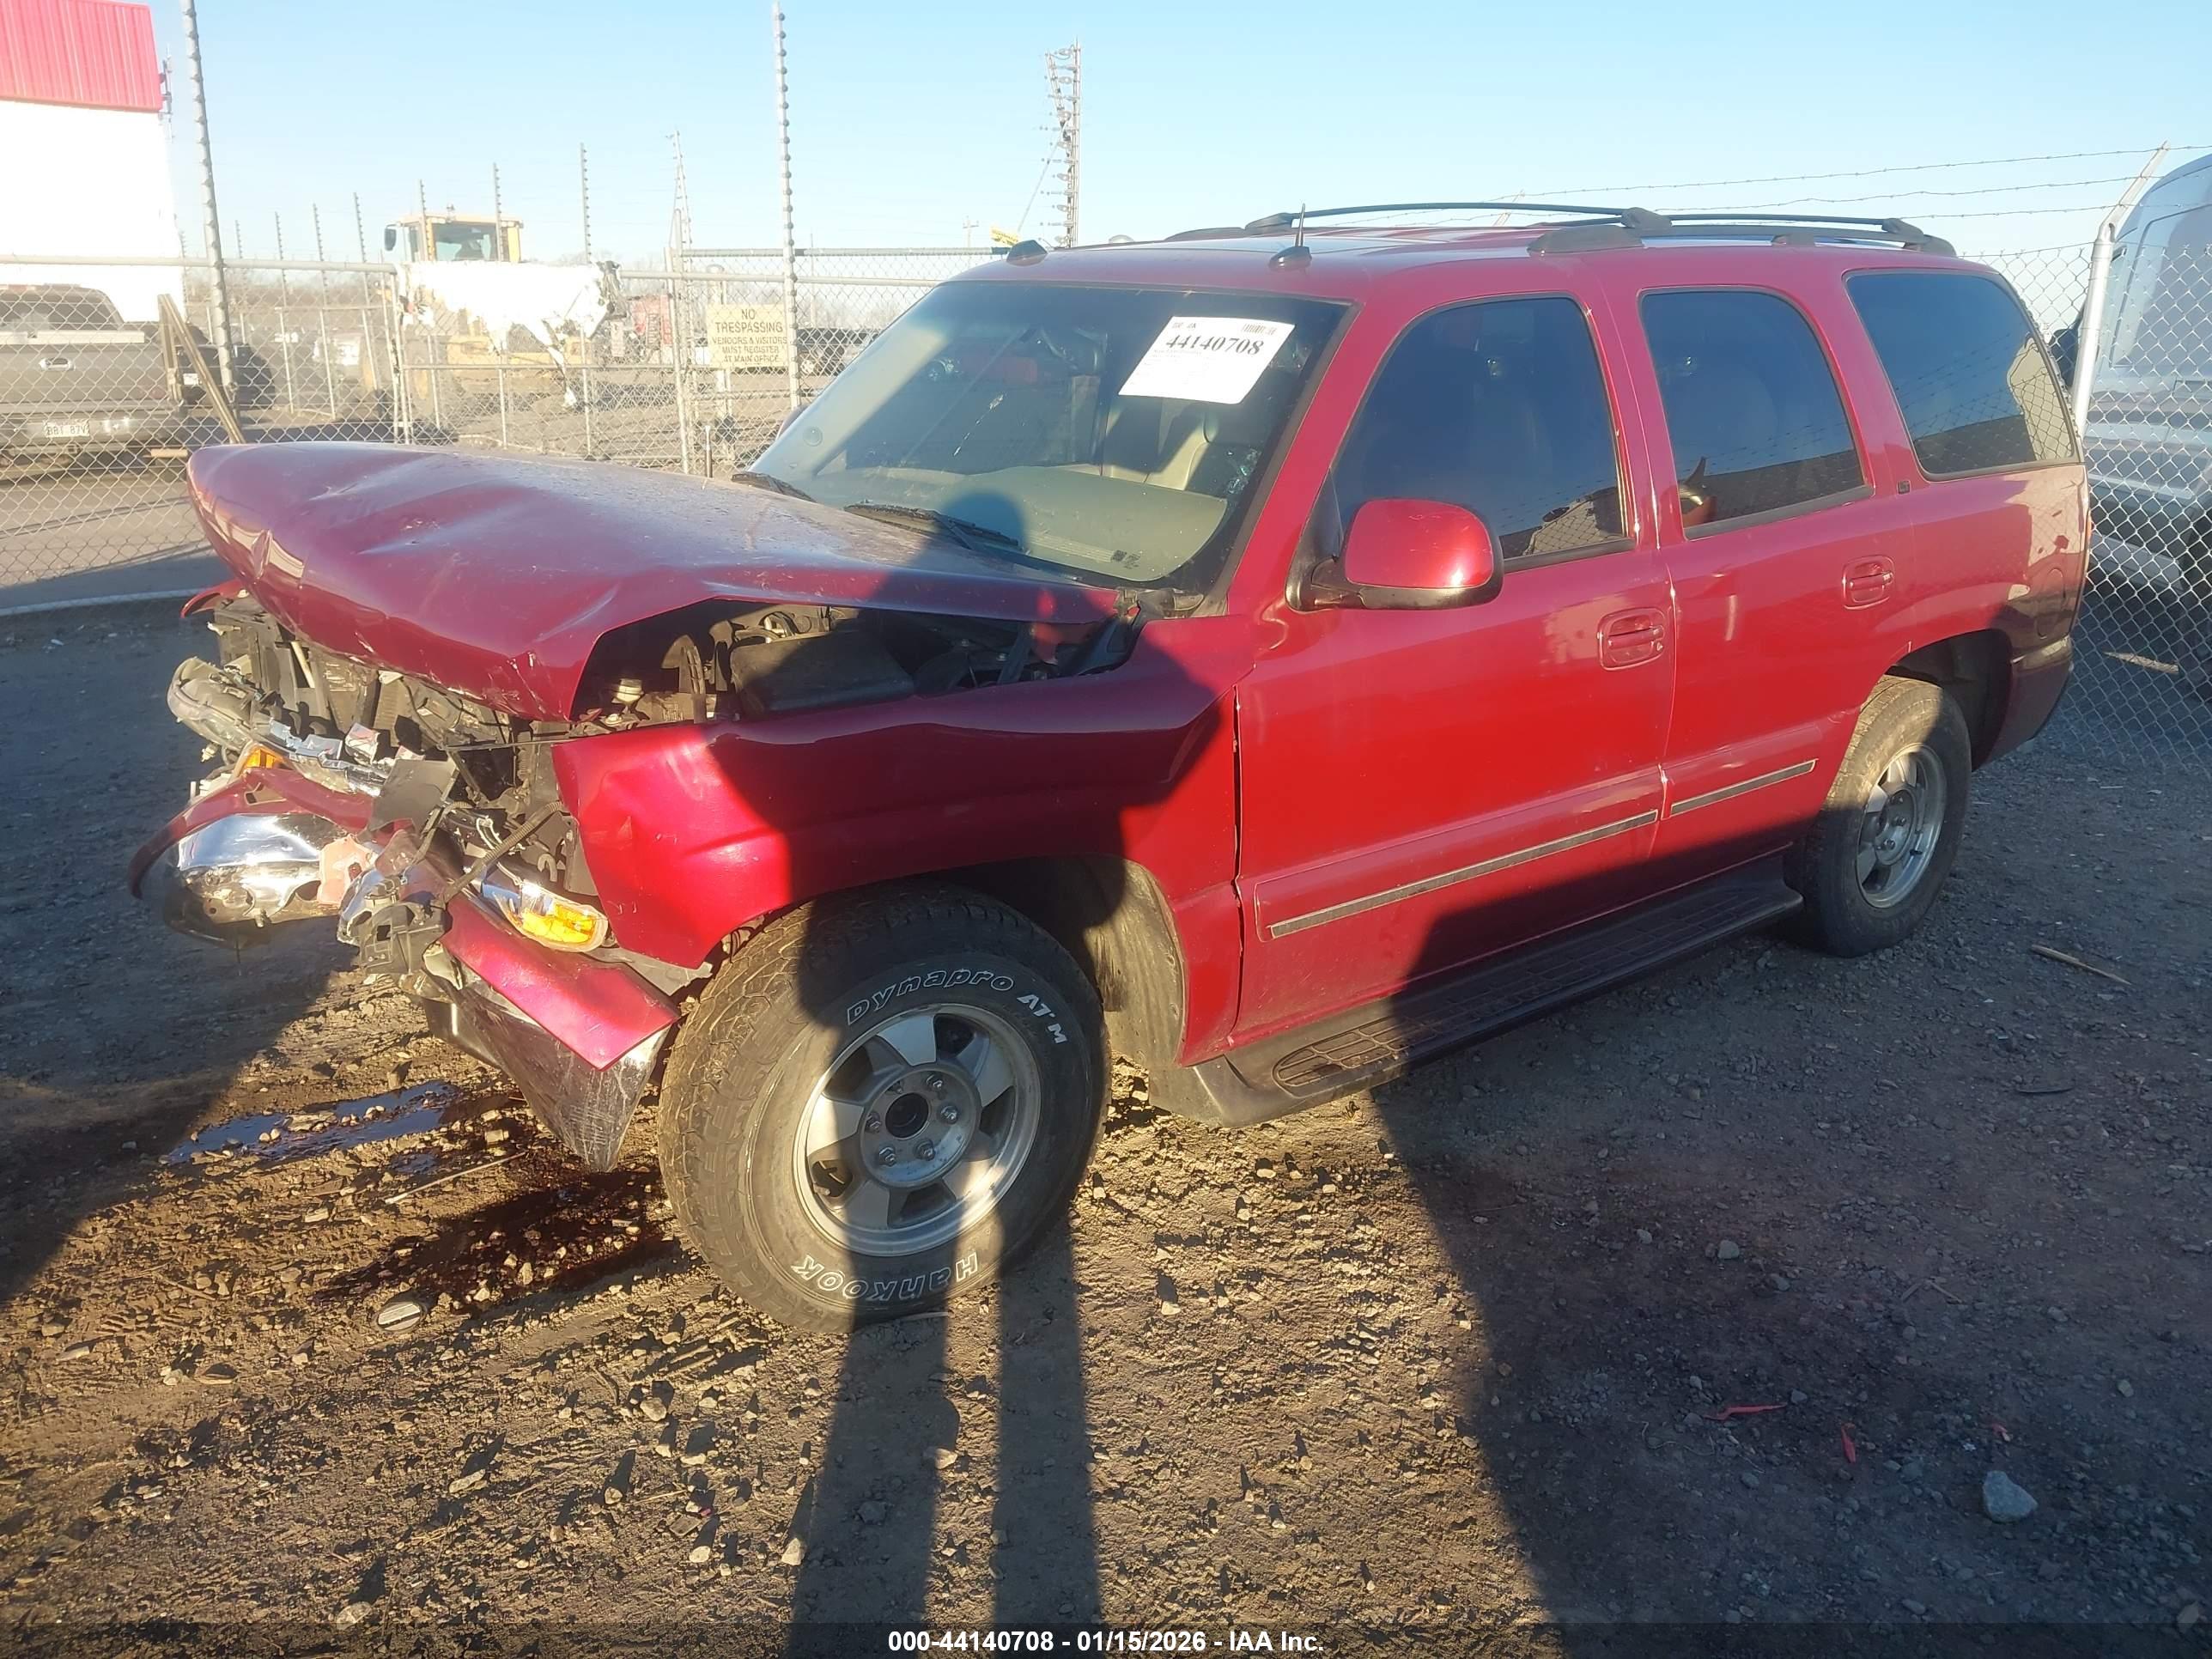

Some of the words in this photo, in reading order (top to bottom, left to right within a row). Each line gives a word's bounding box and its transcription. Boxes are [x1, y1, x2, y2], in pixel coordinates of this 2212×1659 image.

[741, 308, 757, 320] NO
[715, 322, 783, 333] TRESPASSING
[1166, 334, 1265, 356] 44140708
[847, 969, 1014, 1026] Dynapro
